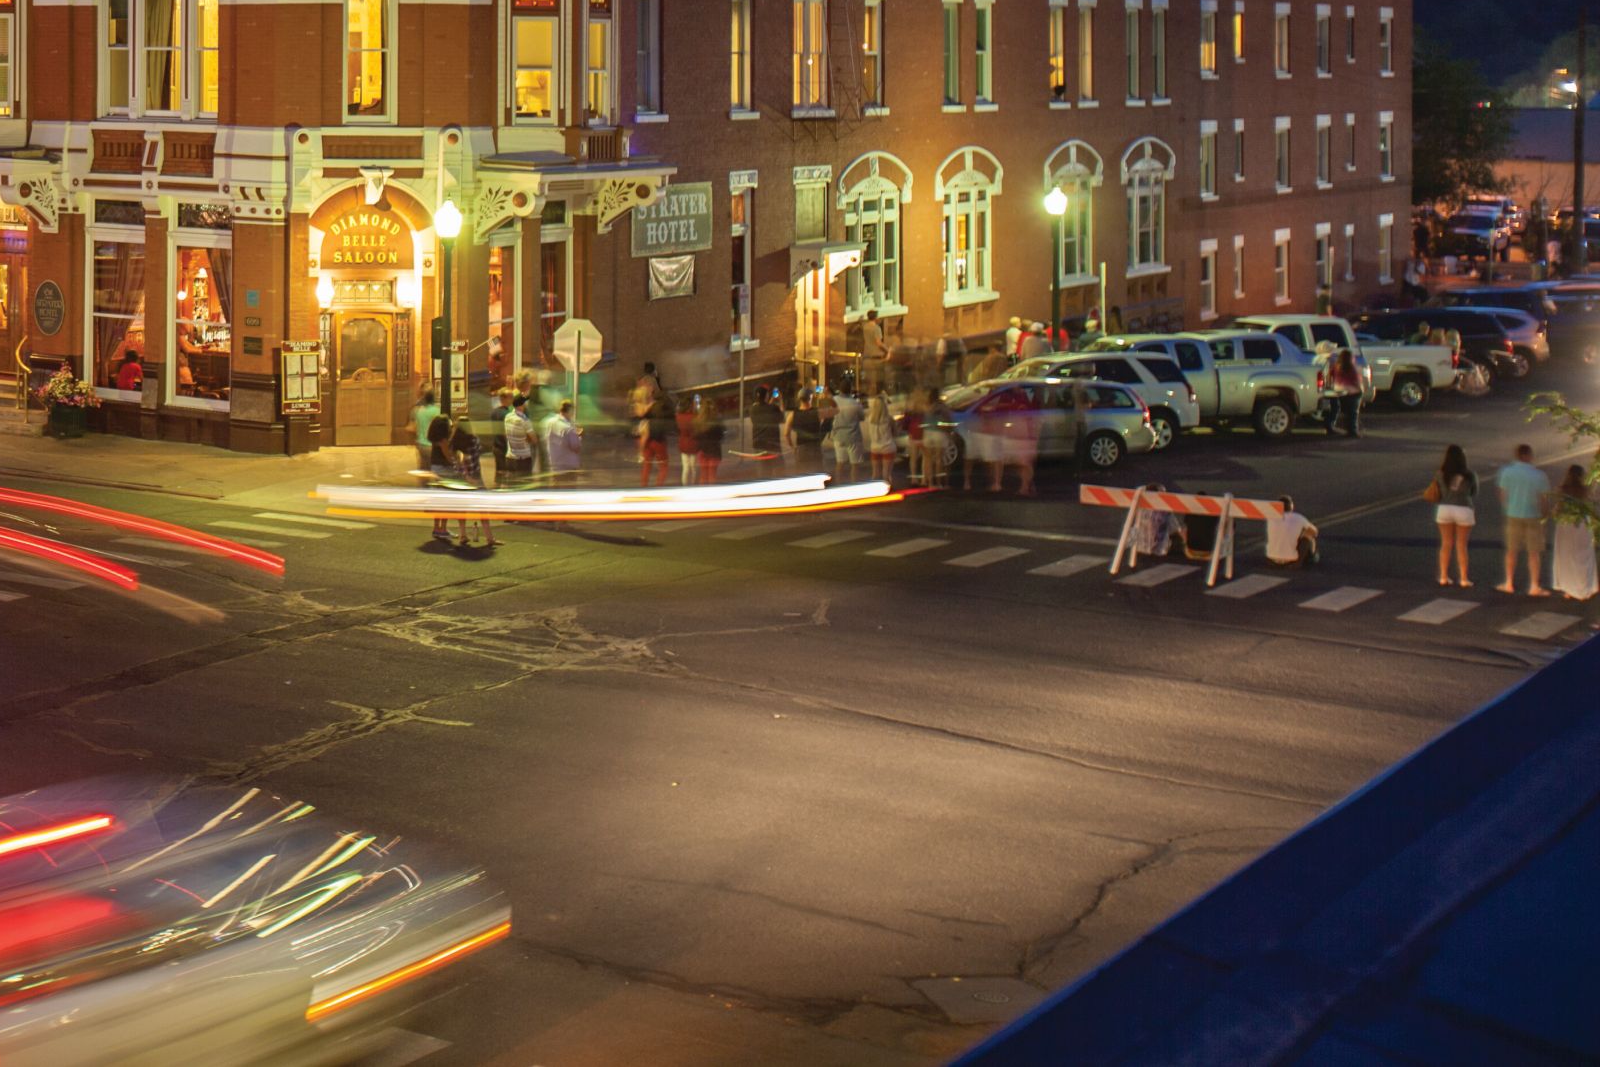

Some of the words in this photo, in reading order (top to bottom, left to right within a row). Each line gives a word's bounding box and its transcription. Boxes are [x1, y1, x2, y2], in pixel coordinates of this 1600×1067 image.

[330, 214, 400, 235] DIAMOND
[646, 219, 698, 245] HOTEL
[343, 235, 386, 247] BELLE
[333, 251, 398, 264] SALOON
